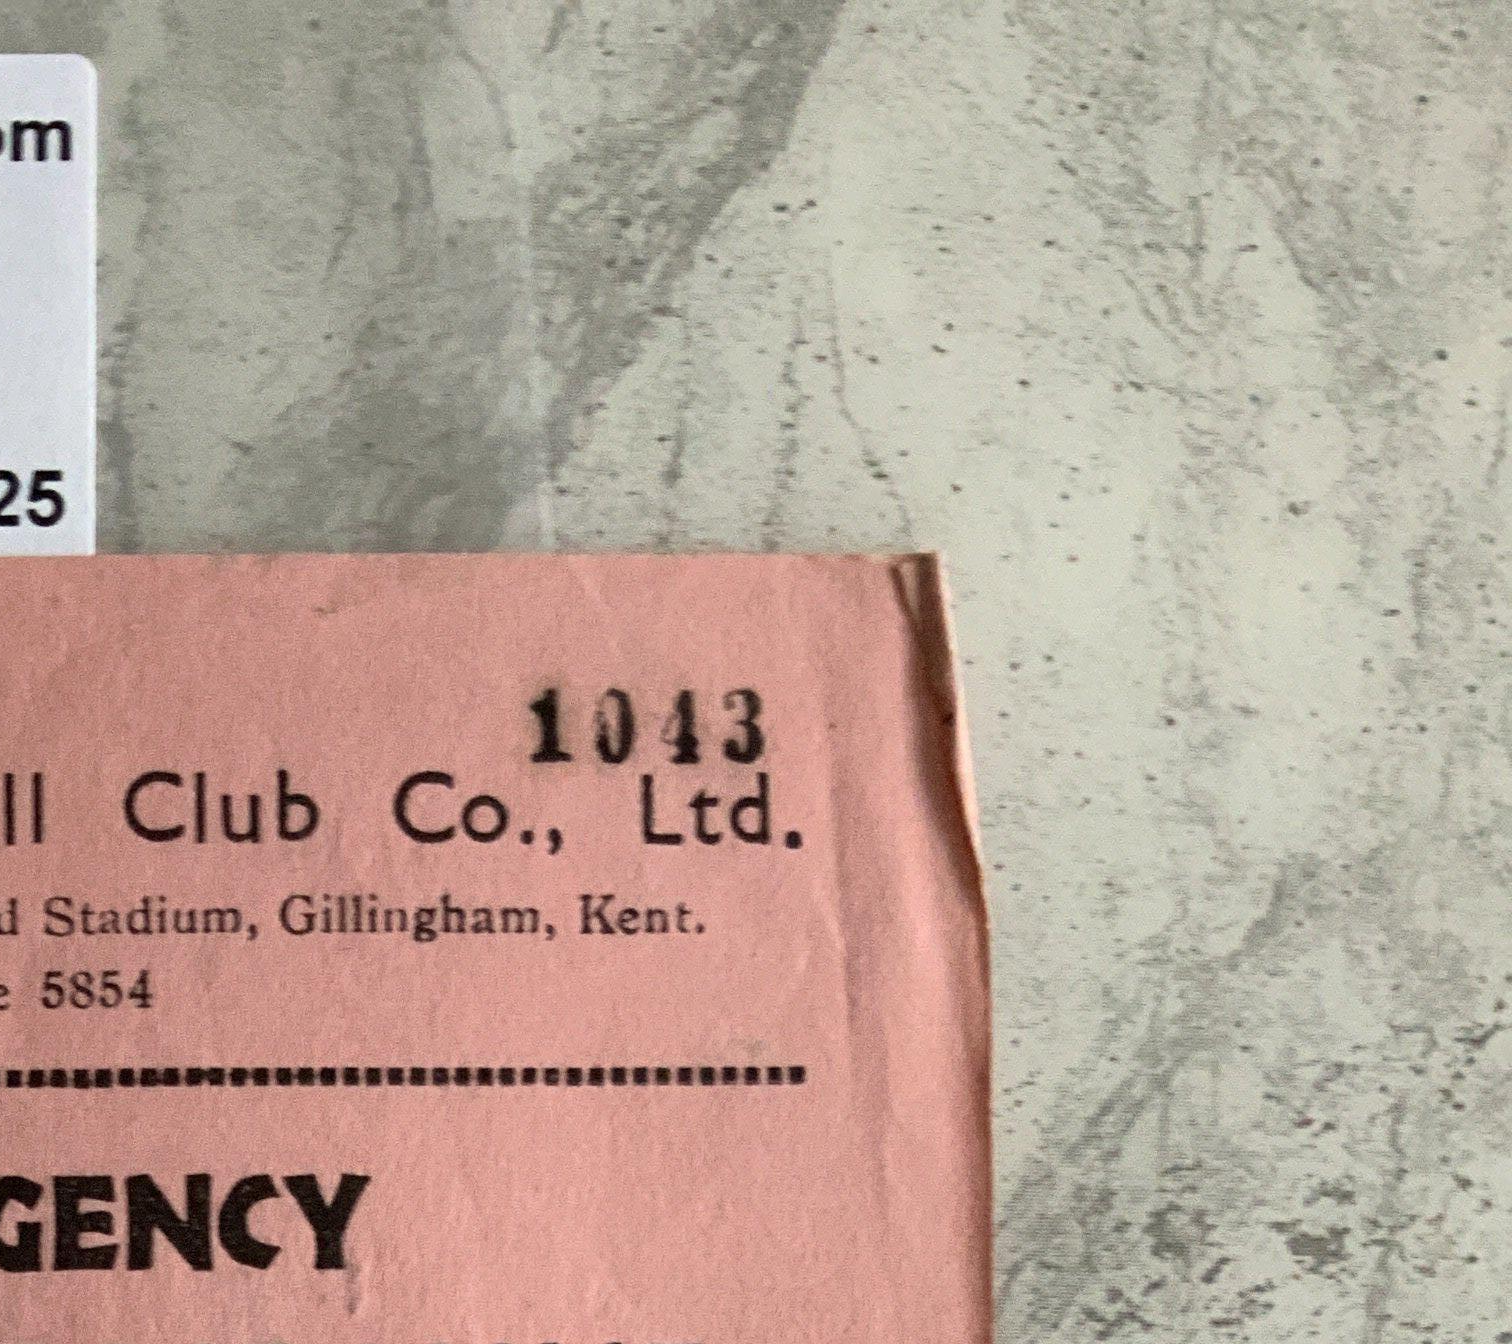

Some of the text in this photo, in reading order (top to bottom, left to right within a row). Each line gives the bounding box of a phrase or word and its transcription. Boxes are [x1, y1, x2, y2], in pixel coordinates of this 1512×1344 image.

[529, 688, 764, 764] 1043
[124, 769, 319, 843] Club
[393, 771, 562, 854] Co.,
[641, 772, 802, 849] Ltd.
[44, 896, 257, 940] Stadium,
[279, 894, 555, 943] Gillingham,
[580, 894, 704, 935] Kent.
[41, 970, 152, 1009] 5854
